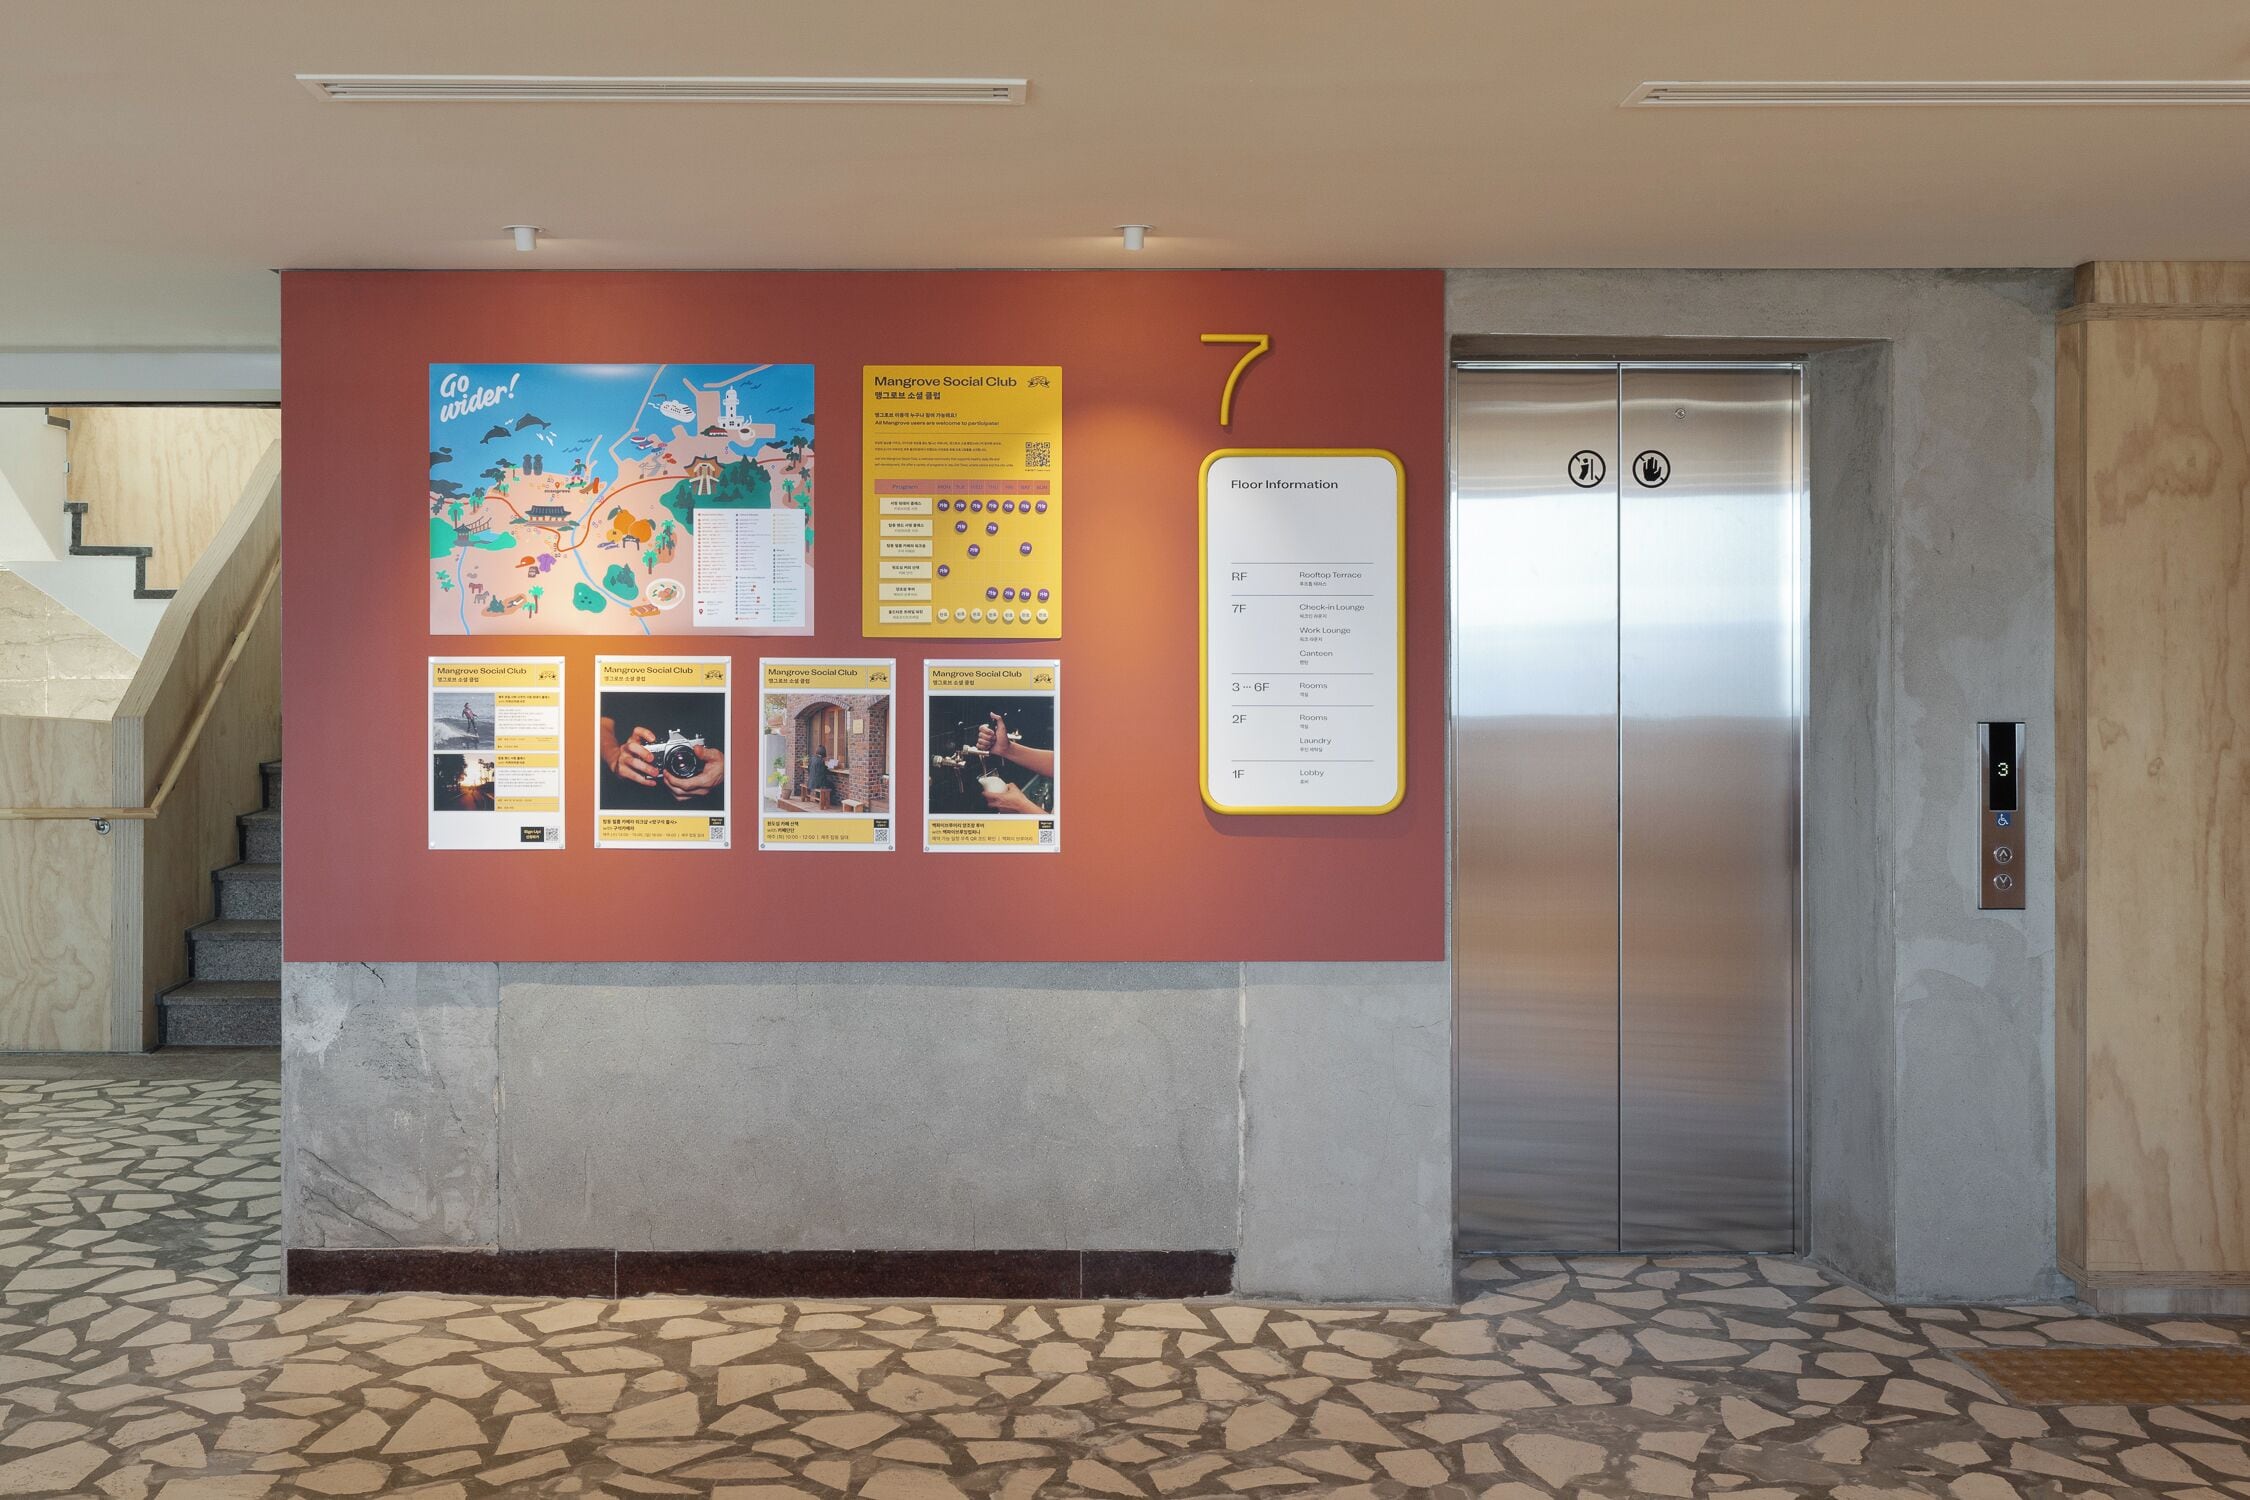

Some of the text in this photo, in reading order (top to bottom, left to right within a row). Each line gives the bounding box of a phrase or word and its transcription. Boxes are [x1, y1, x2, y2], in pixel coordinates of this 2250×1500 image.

[874, 376, 1018, 388] Mangrove Social Club
[1200, 333, 1269, 426] 7
[440, 373, 470, 398] Go
[440, 372, 520, 422] wider!
[874, 392, 940, 400] 맹그로브 소셜 클럽
[1232, 480, 1338, 490] Floor Information
[1232, 572, 1248, 582] RF
[1300, 572, 1332, 580] Rooftop
[1232, 604, 1246, 614] 7F
[1336, 604, 1364, 612] Lounge
[1322, 626, 1350, 634] Lounge
[438, 668, 478, 676] Mangrove
[604, 666, 646, 674] Mangrove
[768, 668, 810, 678] Mangrove
[838, 668, 858, 676] Club
[932, 670, 974, 678] Mangrove
[1232, 682, 1270, 692] 3 6F
[1232, 715, 1246, 724] 2F
[1300, 738, 1332, 746] Laundry
[1998, 762, 2009, 776] 3
[1232, 770, 1245, 779] 1F
[1300, 770, 1324, 778] Lobby
